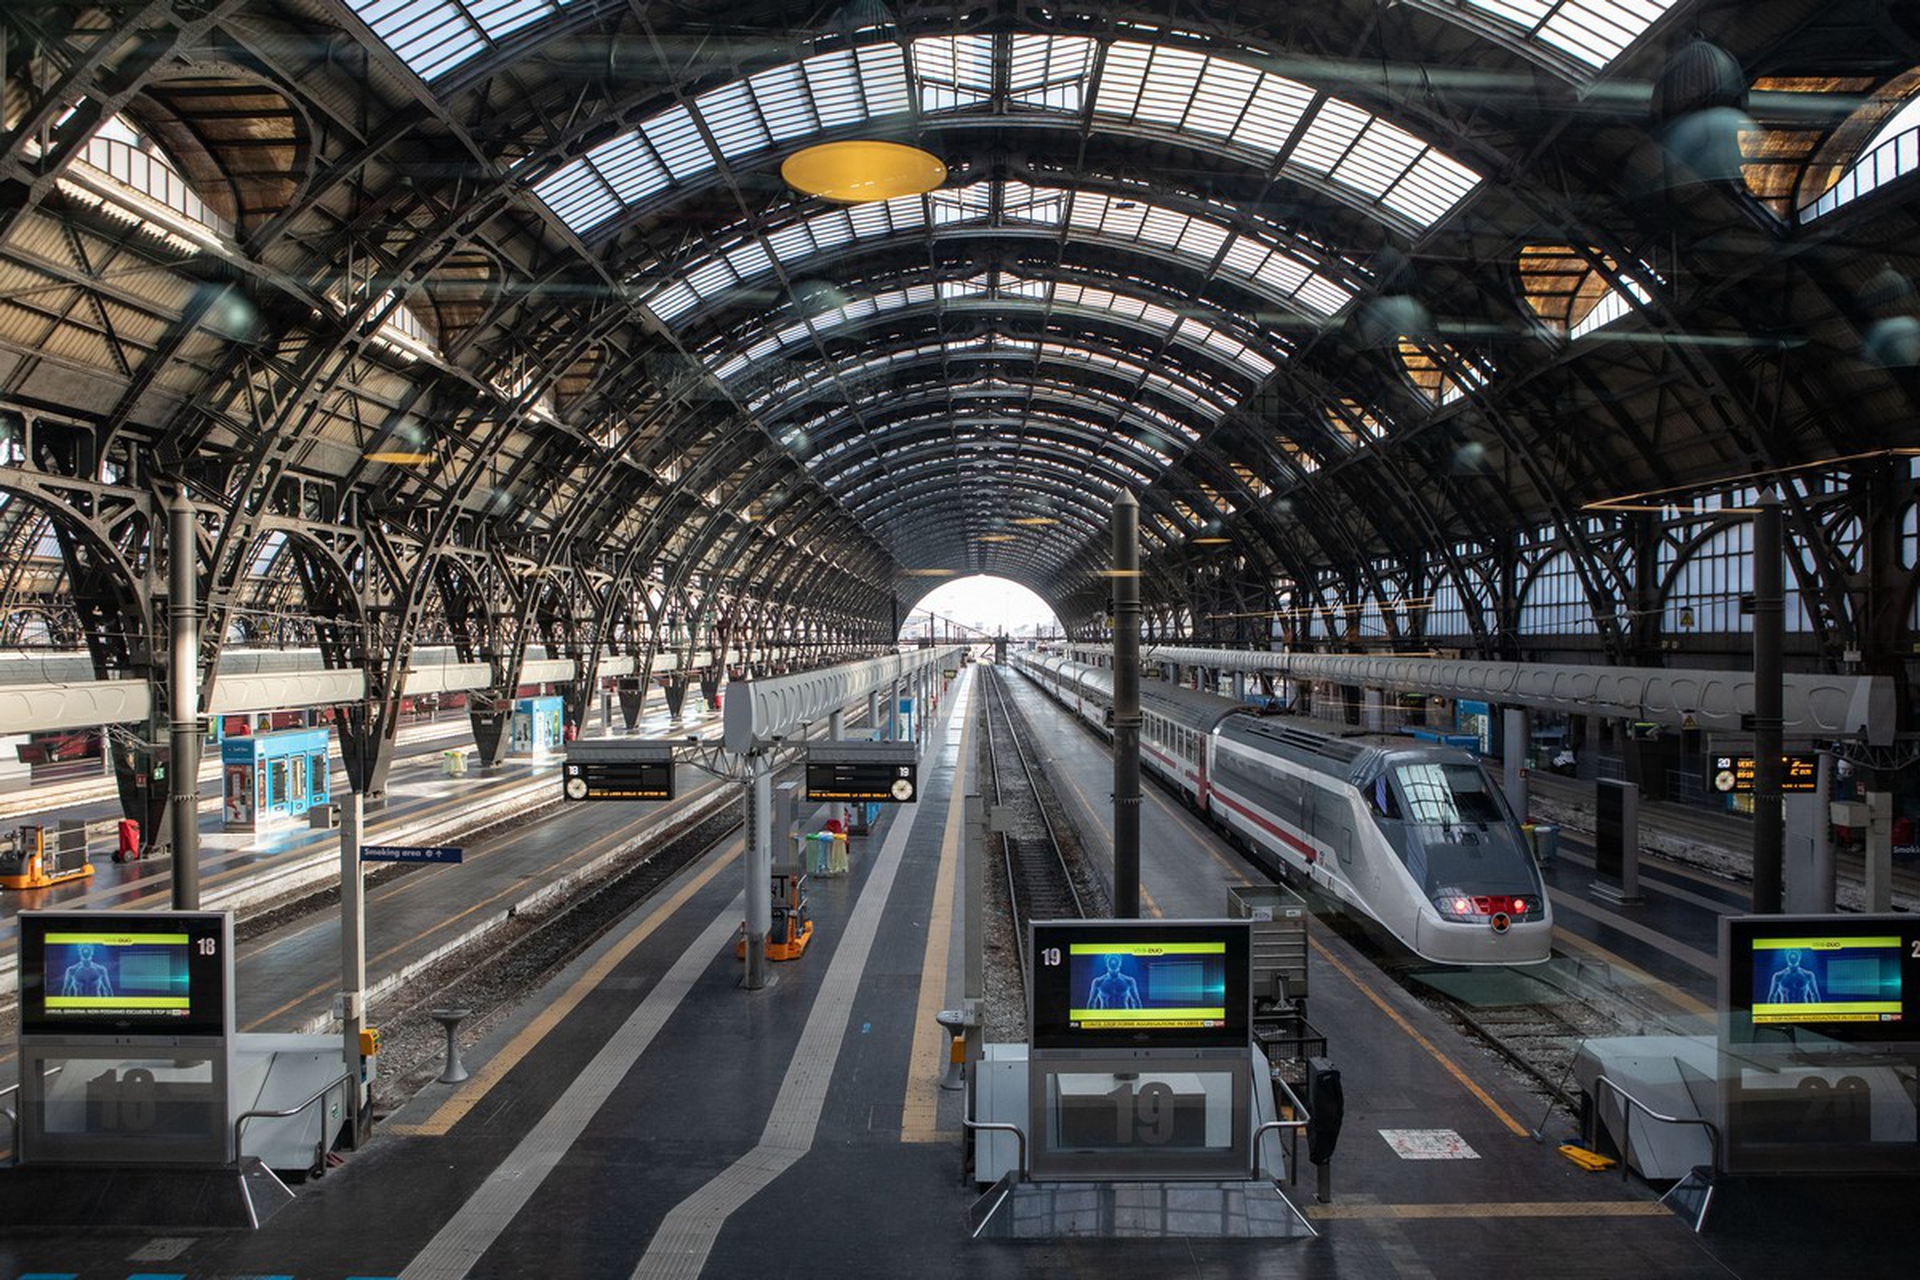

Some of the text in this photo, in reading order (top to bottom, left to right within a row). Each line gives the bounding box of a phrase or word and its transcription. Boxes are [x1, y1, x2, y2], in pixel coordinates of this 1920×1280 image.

[568, 765, 579, 776] 18
[1717, 758, 1731, 768] 20
[899, 766, 910, 777] 19
[364, 848, 421, 858] Smoking area
[197, 937, 216, 956] 18
[1041, 947, 1062, 966] 19
[92, 1068, 156, 1131] 18
[1106, 1081, 1175, 1145] 19
